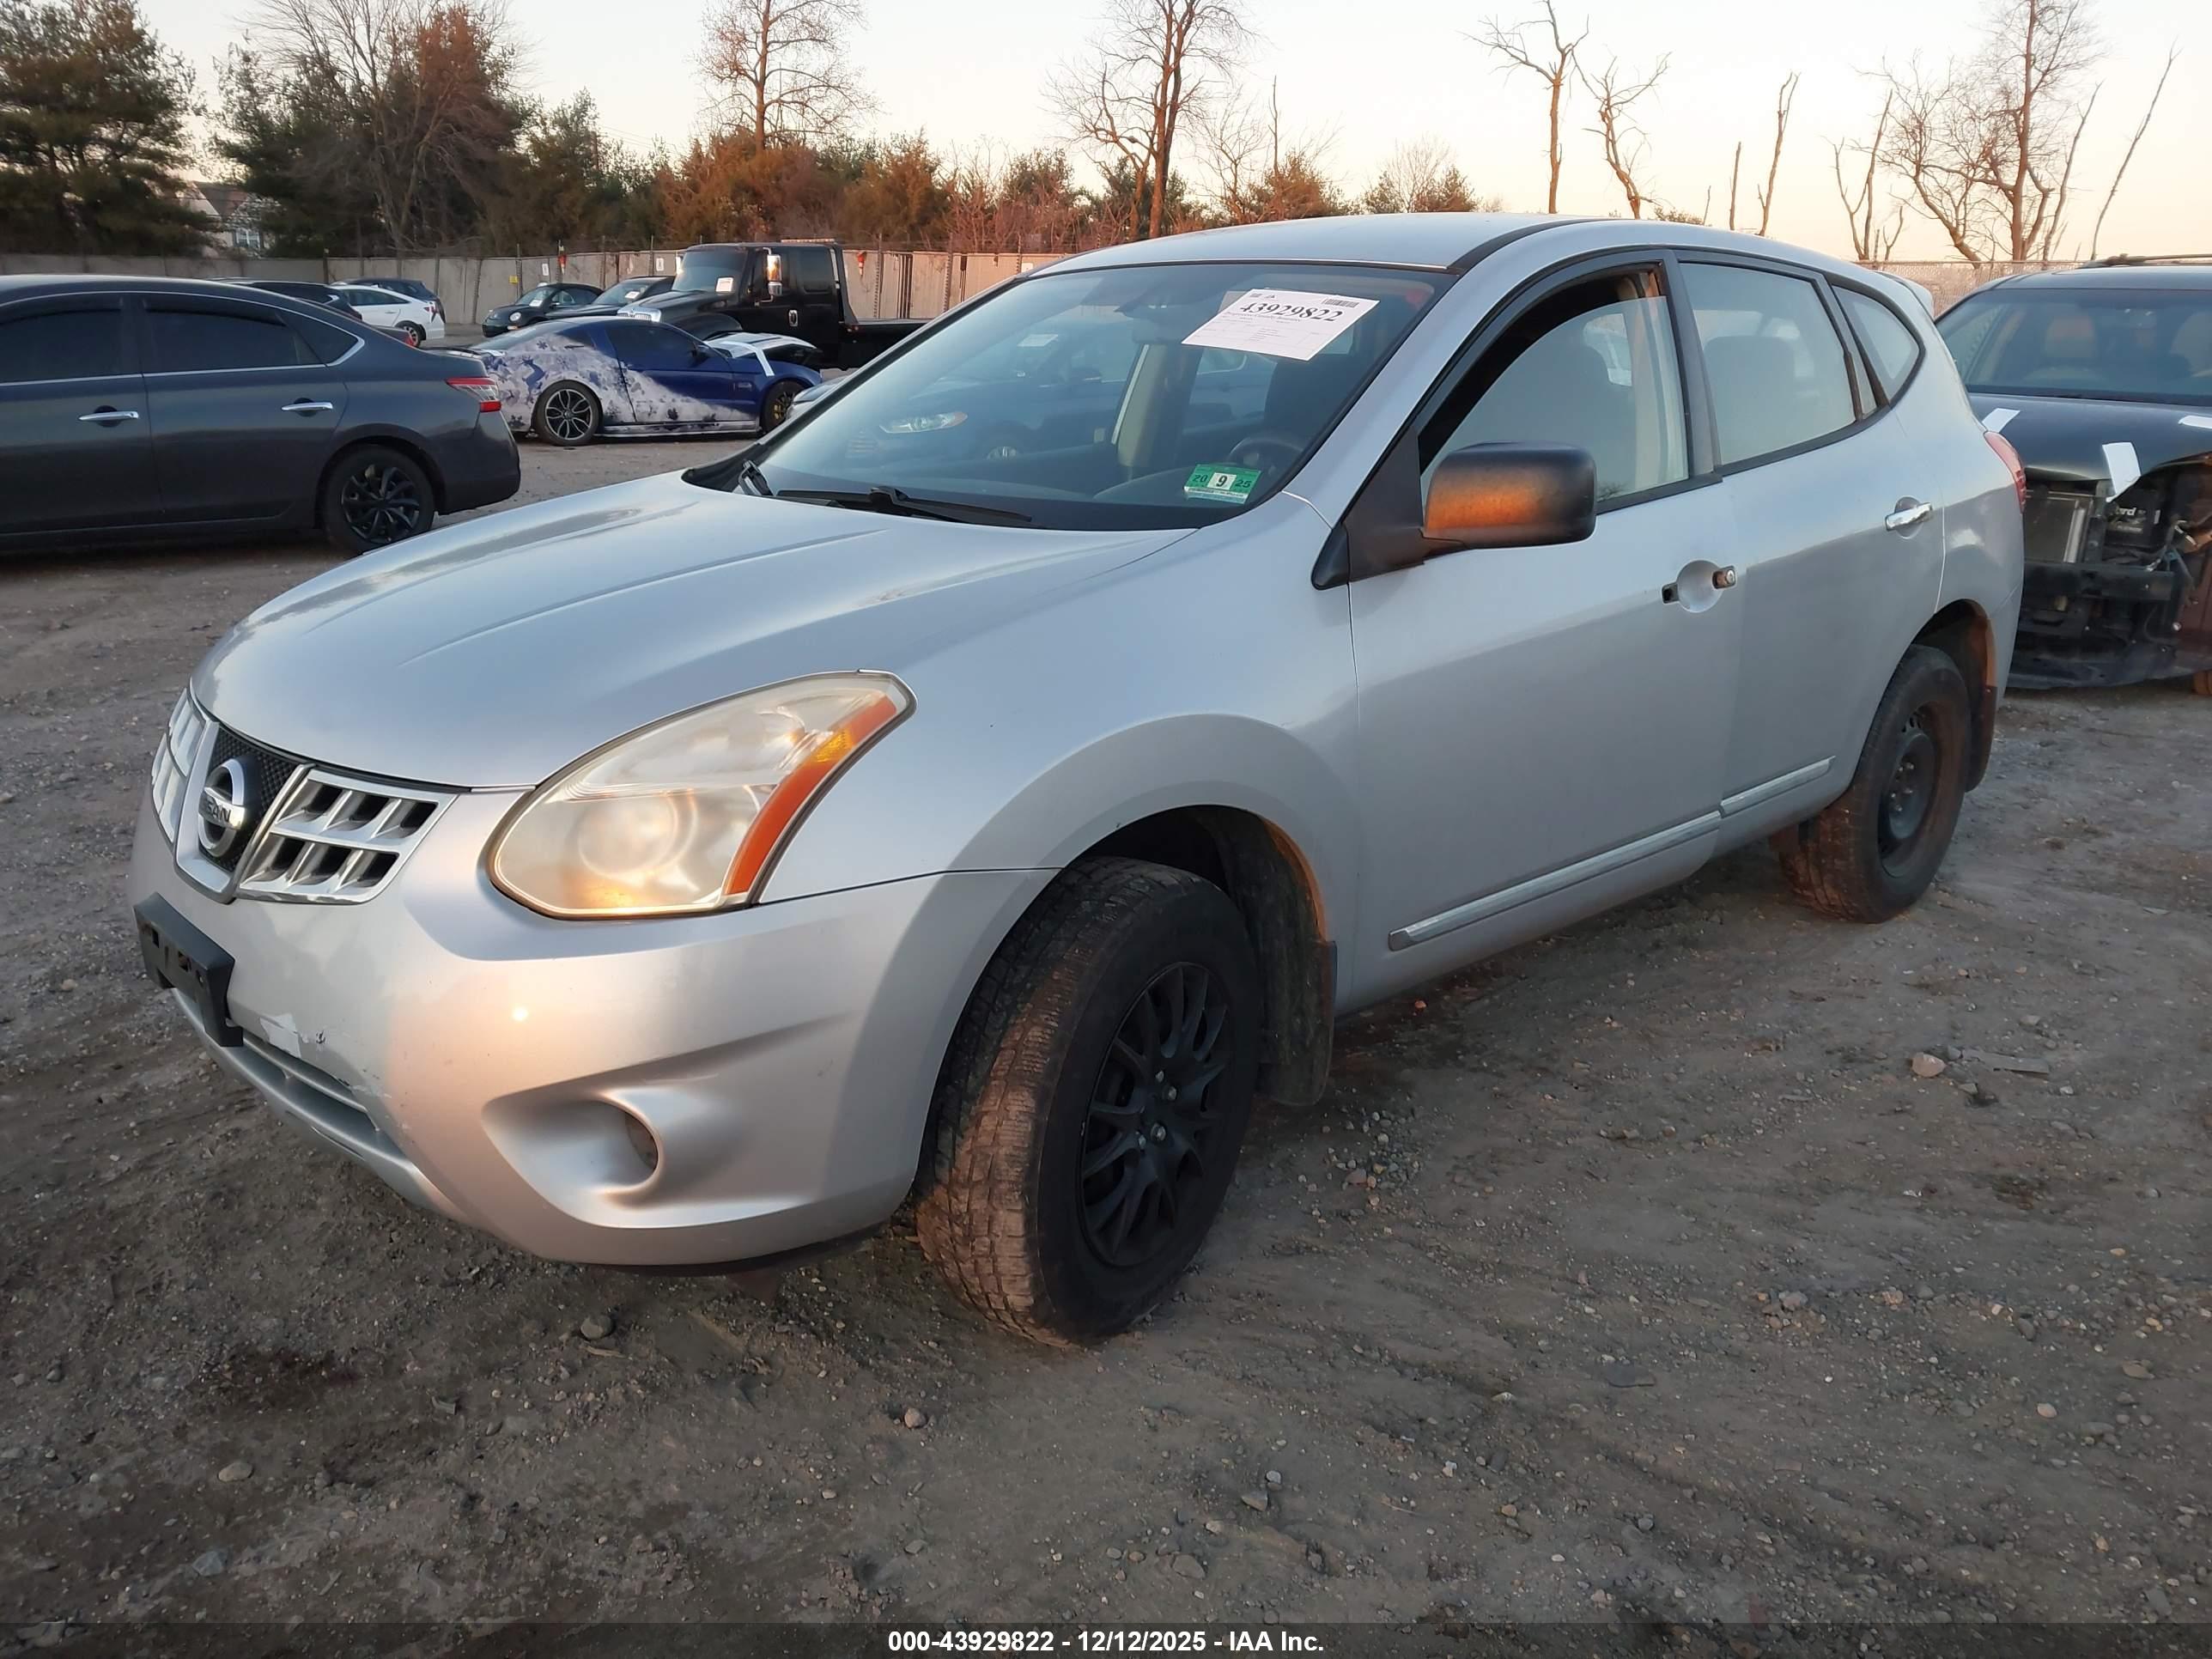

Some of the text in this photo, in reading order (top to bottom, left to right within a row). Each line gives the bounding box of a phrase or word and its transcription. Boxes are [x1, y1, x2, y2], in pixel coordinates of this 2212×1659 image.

[1240, 301, 1344, 322] 43929822
[1192, 474, 1252, 489] 20 9 25
